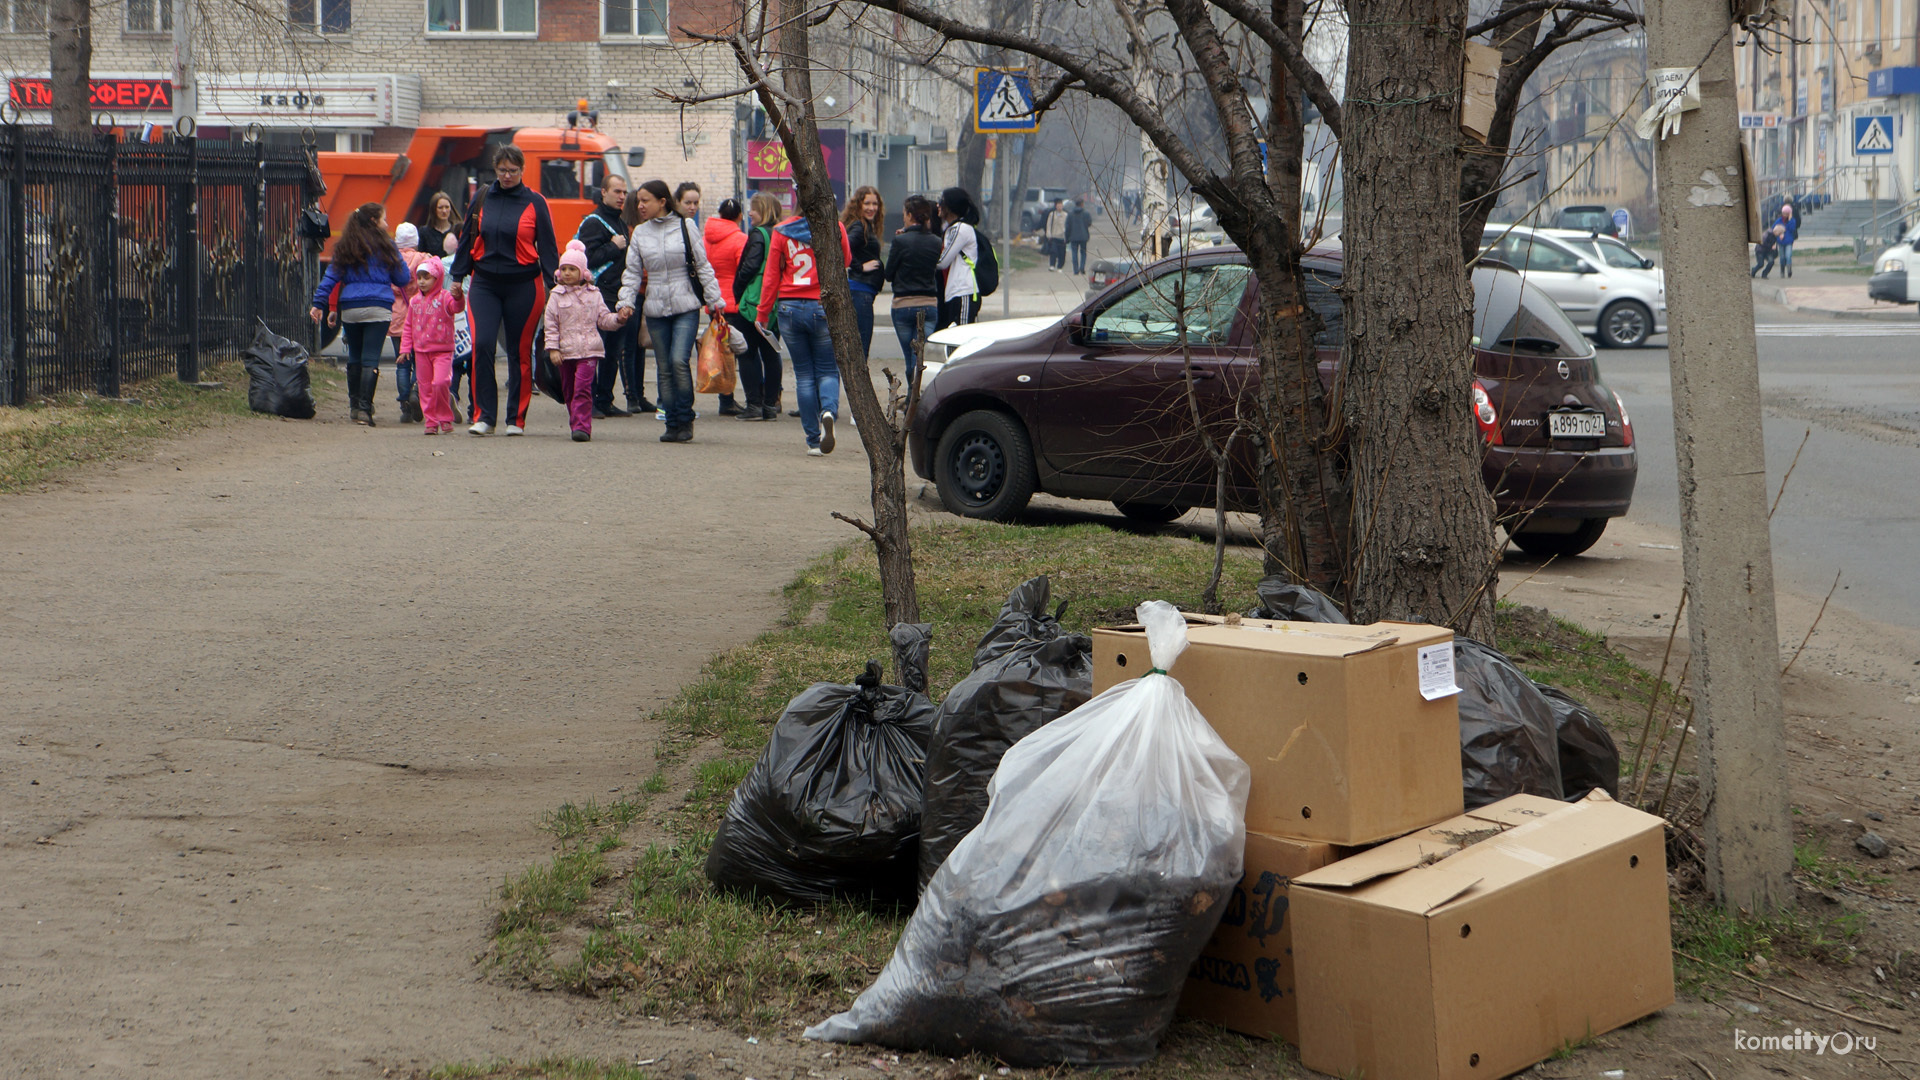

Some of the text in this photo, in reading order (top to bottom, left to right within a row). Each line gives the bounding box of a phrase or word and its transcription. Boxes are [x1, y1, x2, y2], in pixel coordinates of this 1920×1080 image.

[10, 82, 169, 105] АТМСФЕРА
[793, 252, 812, 285] 2
[1510, 419, 1539, 427] MARCH
